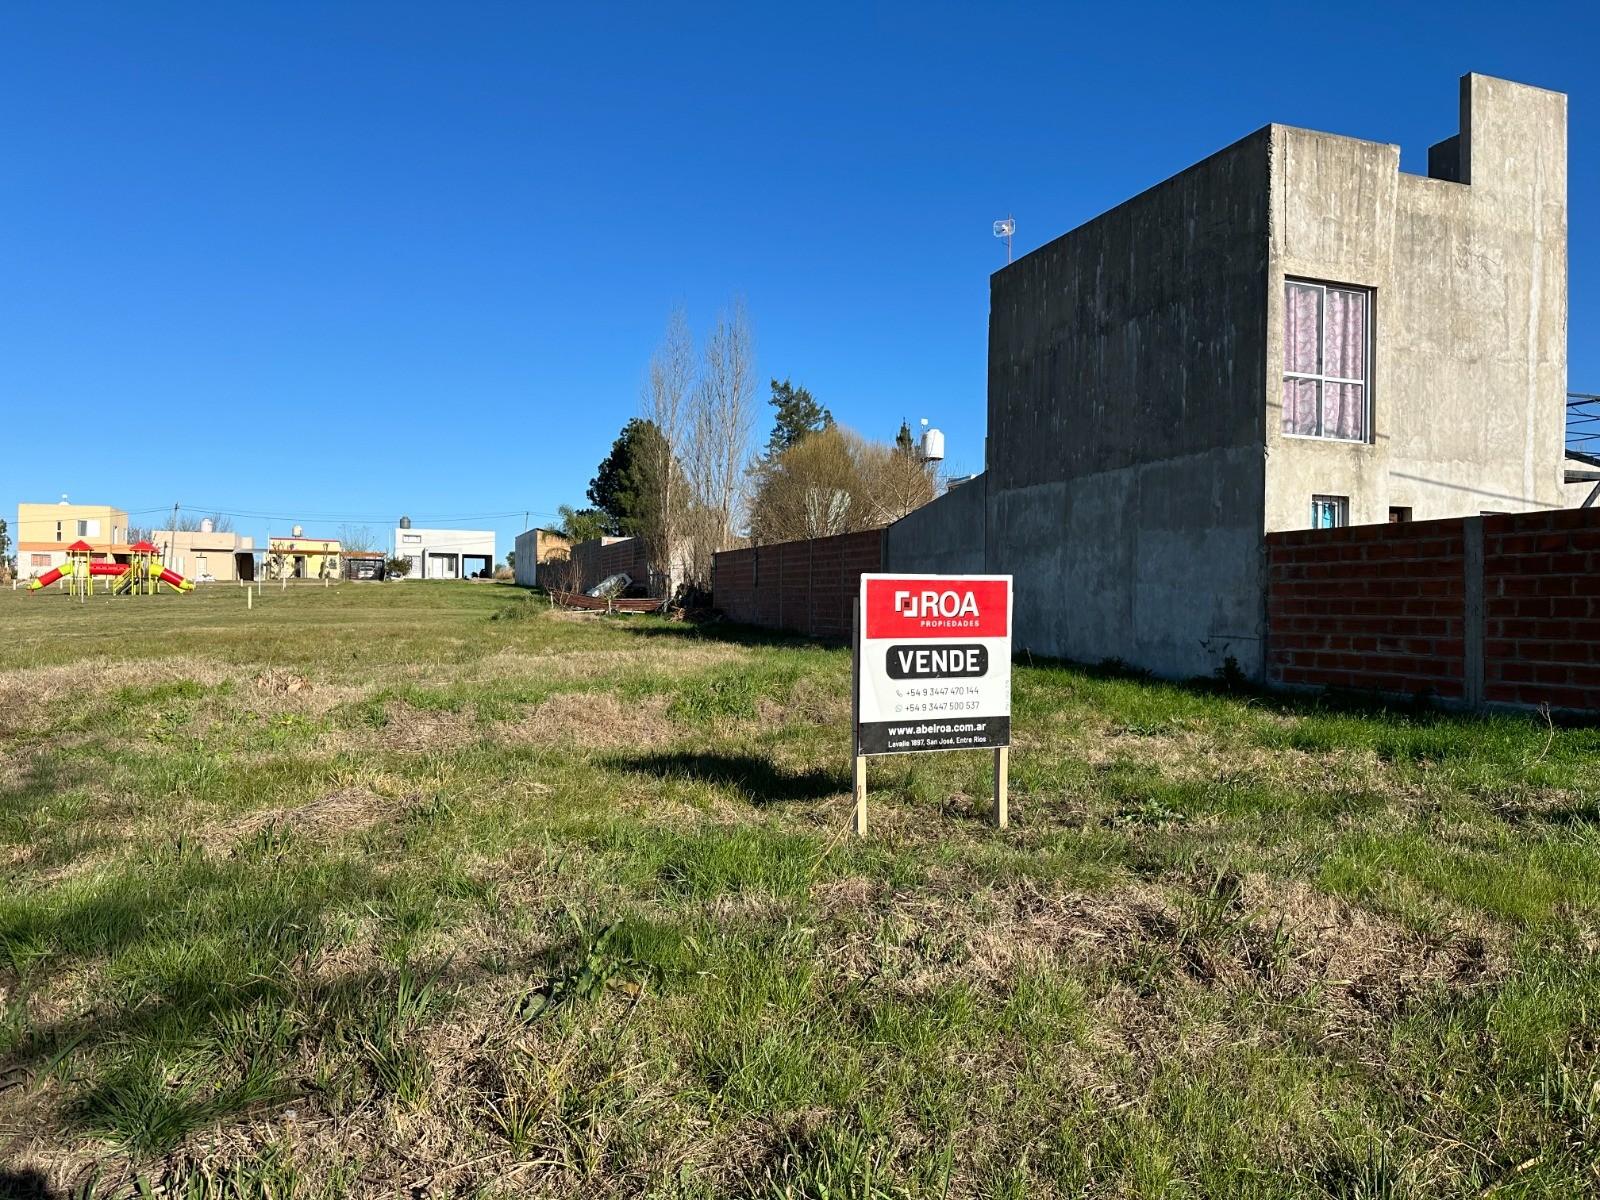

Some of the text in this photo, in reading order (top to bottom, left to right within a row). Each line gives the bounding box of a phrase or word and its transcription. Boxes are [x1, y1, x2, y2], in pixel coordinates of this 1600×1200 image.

[921, 591, 979, 618] ROA
[898, 650, 979, 673] VENDE
[930, 688, 948, 696] 3447
[951, 687, 964, 695] 470
[966, 686, 979, 694] 144
[905, 704, 920, 712] +54
[929, 703, 947, 711] 3447
[949, 702, 964, 710] 500
[888, 723, 986, 735] www.abelroa.com.ar
